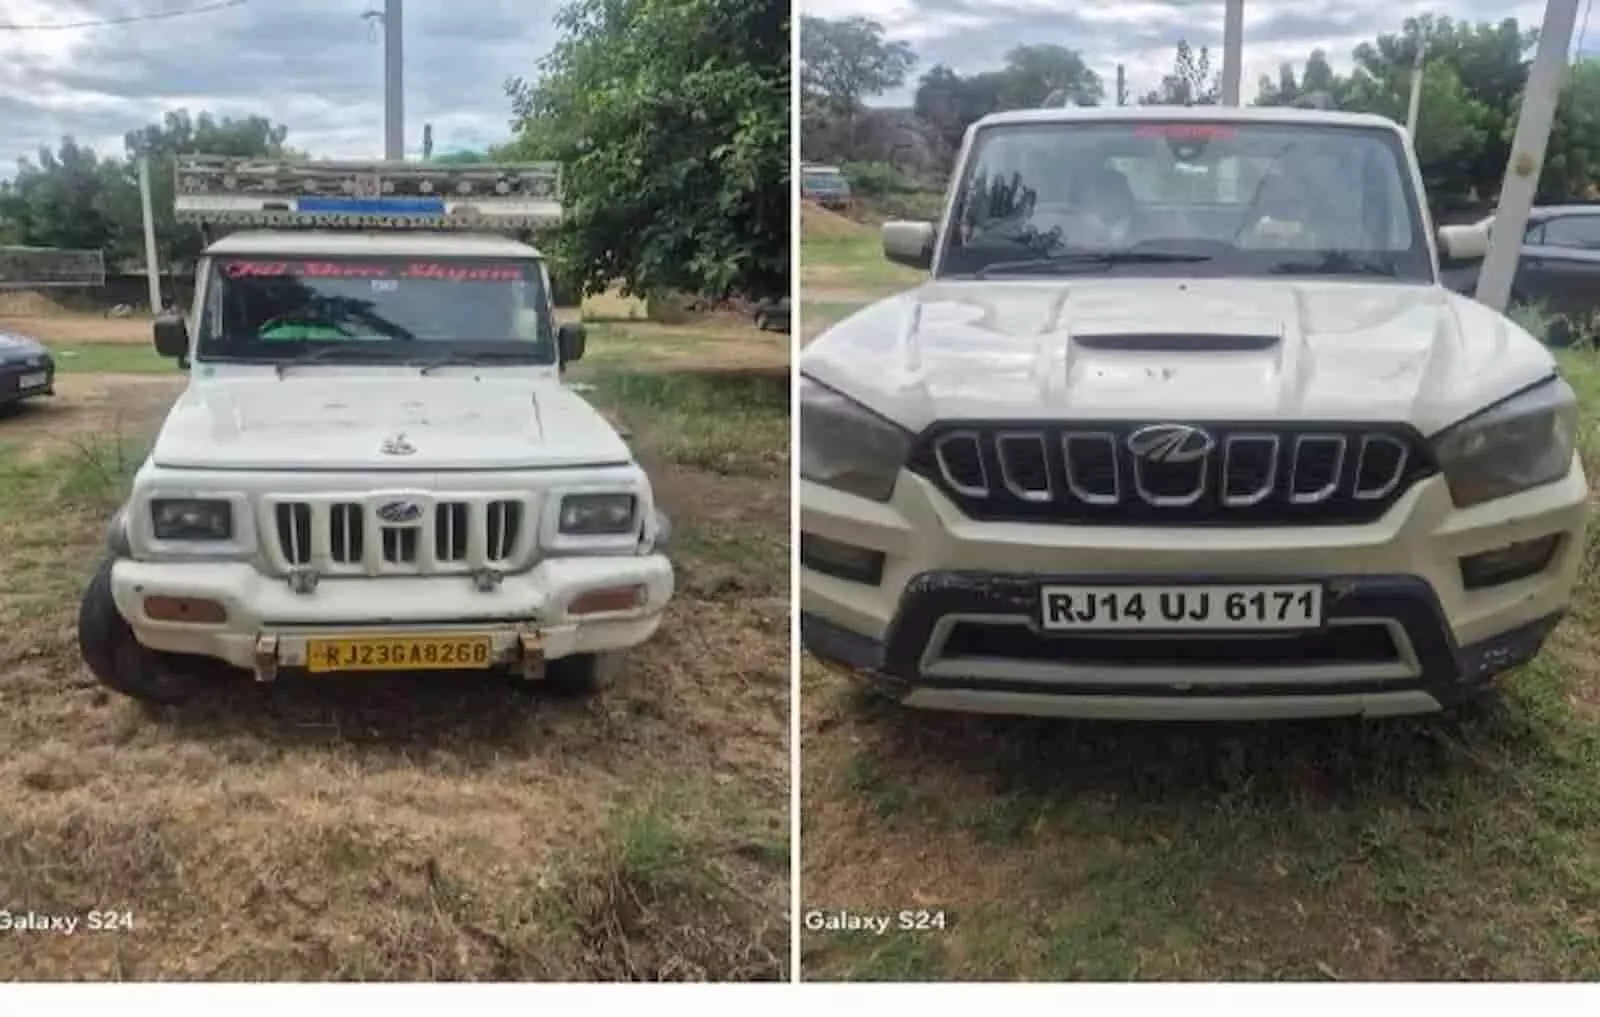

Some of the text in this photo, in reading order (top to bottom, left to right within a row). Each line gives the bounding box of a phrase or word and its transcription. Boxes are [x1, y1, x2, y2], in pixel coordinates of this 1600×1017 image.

[1047, 590, 1314, 622] RJ14 UJ 6171
